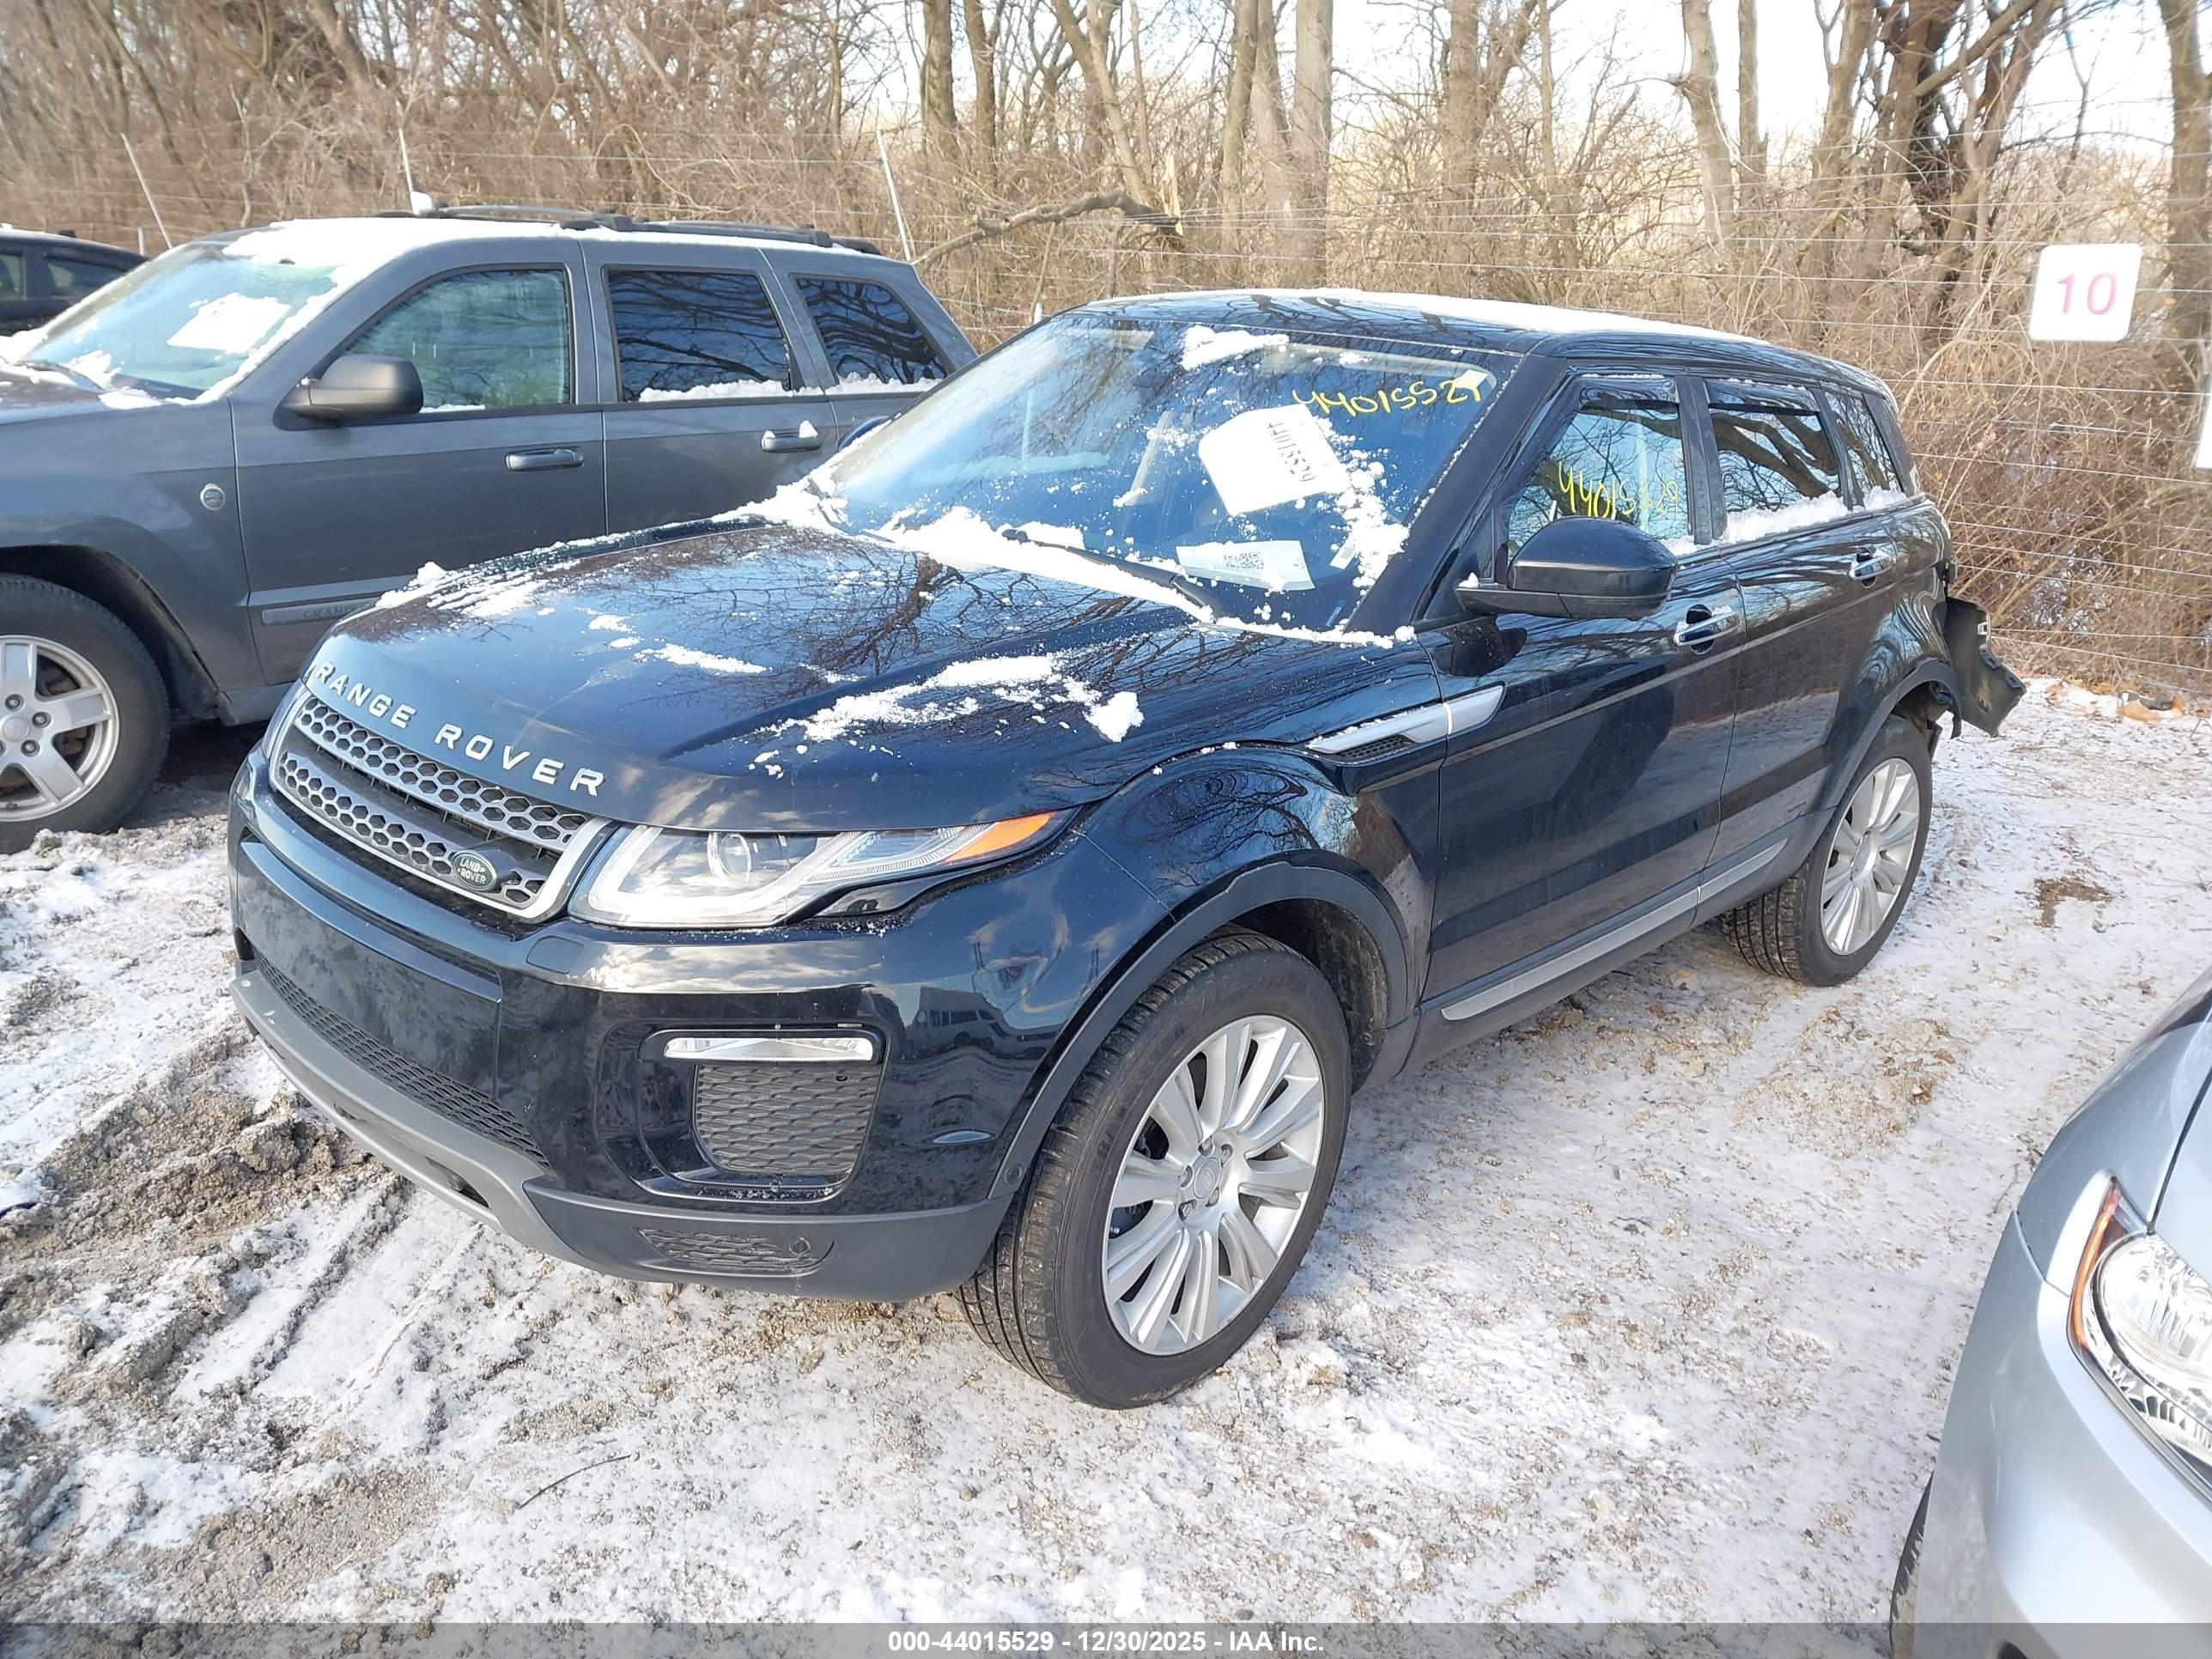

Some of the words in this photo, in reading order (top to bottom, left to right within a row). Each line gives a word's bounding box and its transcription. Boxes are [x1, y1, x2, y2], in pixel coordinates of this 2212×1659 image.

[2057, 271, 2118, 315] 10
[316, 660, 417, 730] RANGE
[434, 722, 606, 798] ROVER
[459, 857, 482, 872] LAND
[460, 867, 487, 885] ROVER
